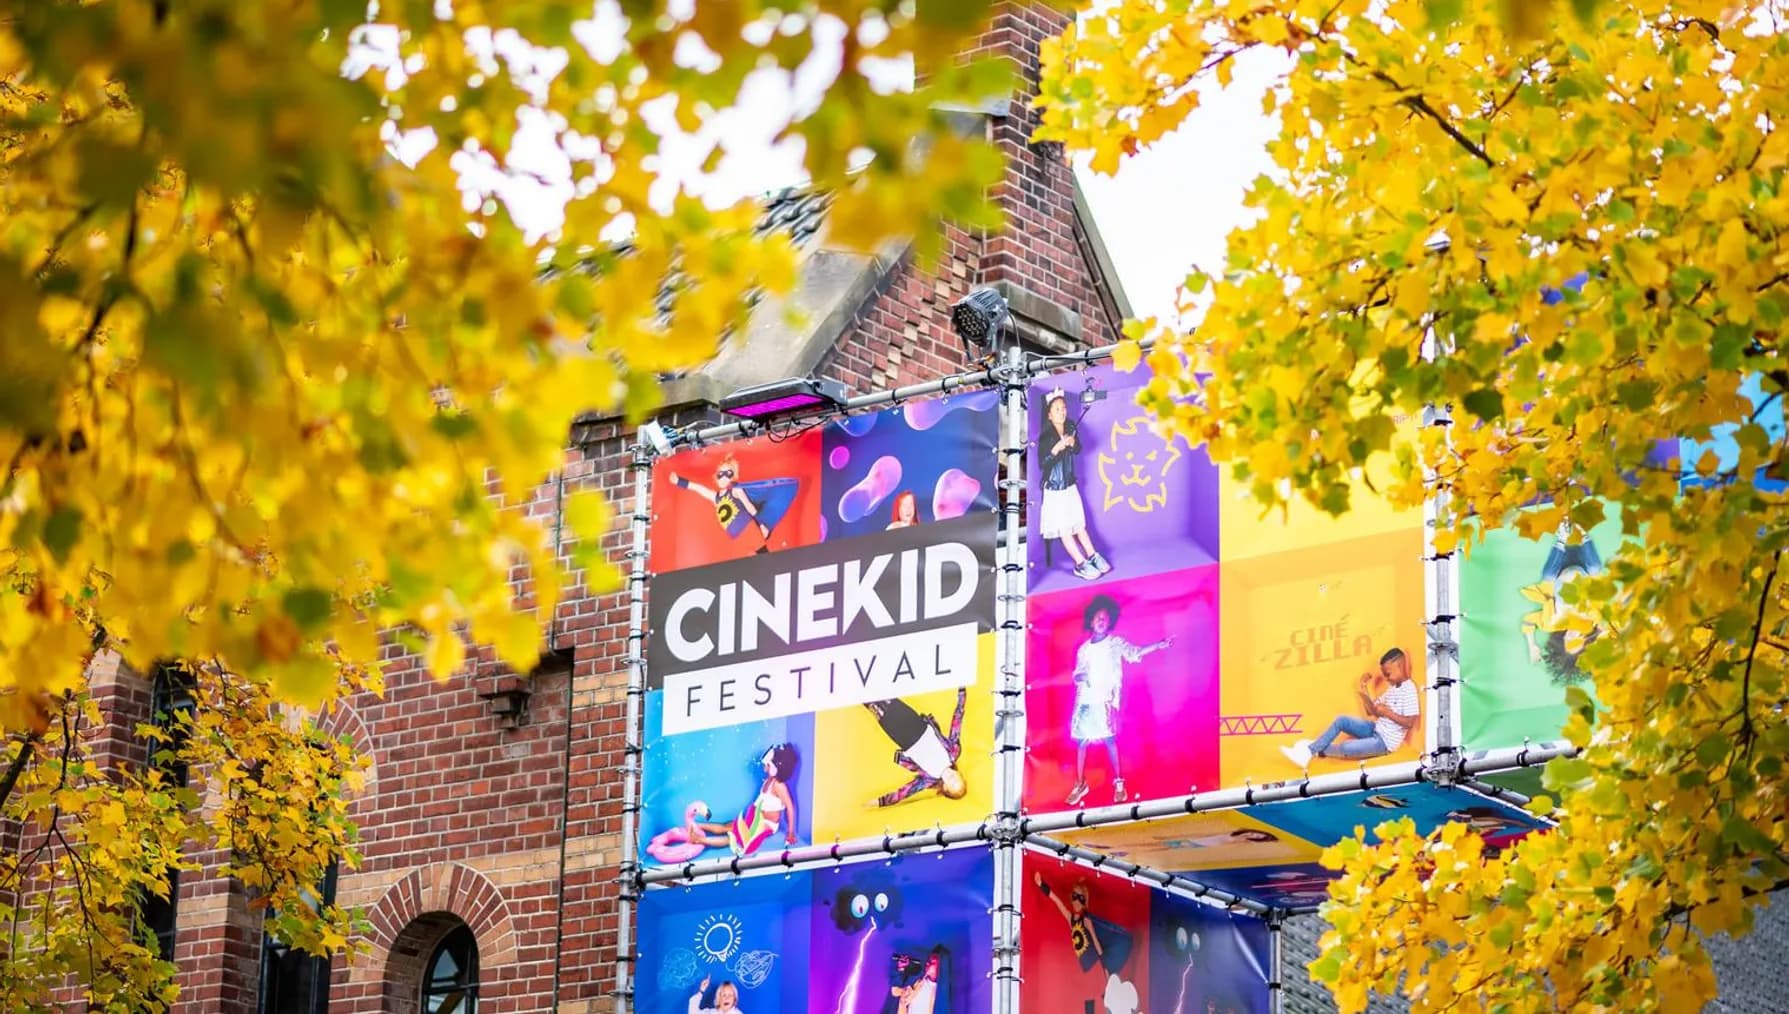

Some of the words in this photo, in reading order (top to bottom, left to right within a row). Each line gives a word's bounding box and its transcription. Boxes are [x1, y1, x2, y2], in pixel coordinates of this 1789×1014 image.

[664, 542, 979, 662] CINEKID
[687, 644, 951, 717] FESTIVAL
[1274, 634, 1372, 670] ZILLA
